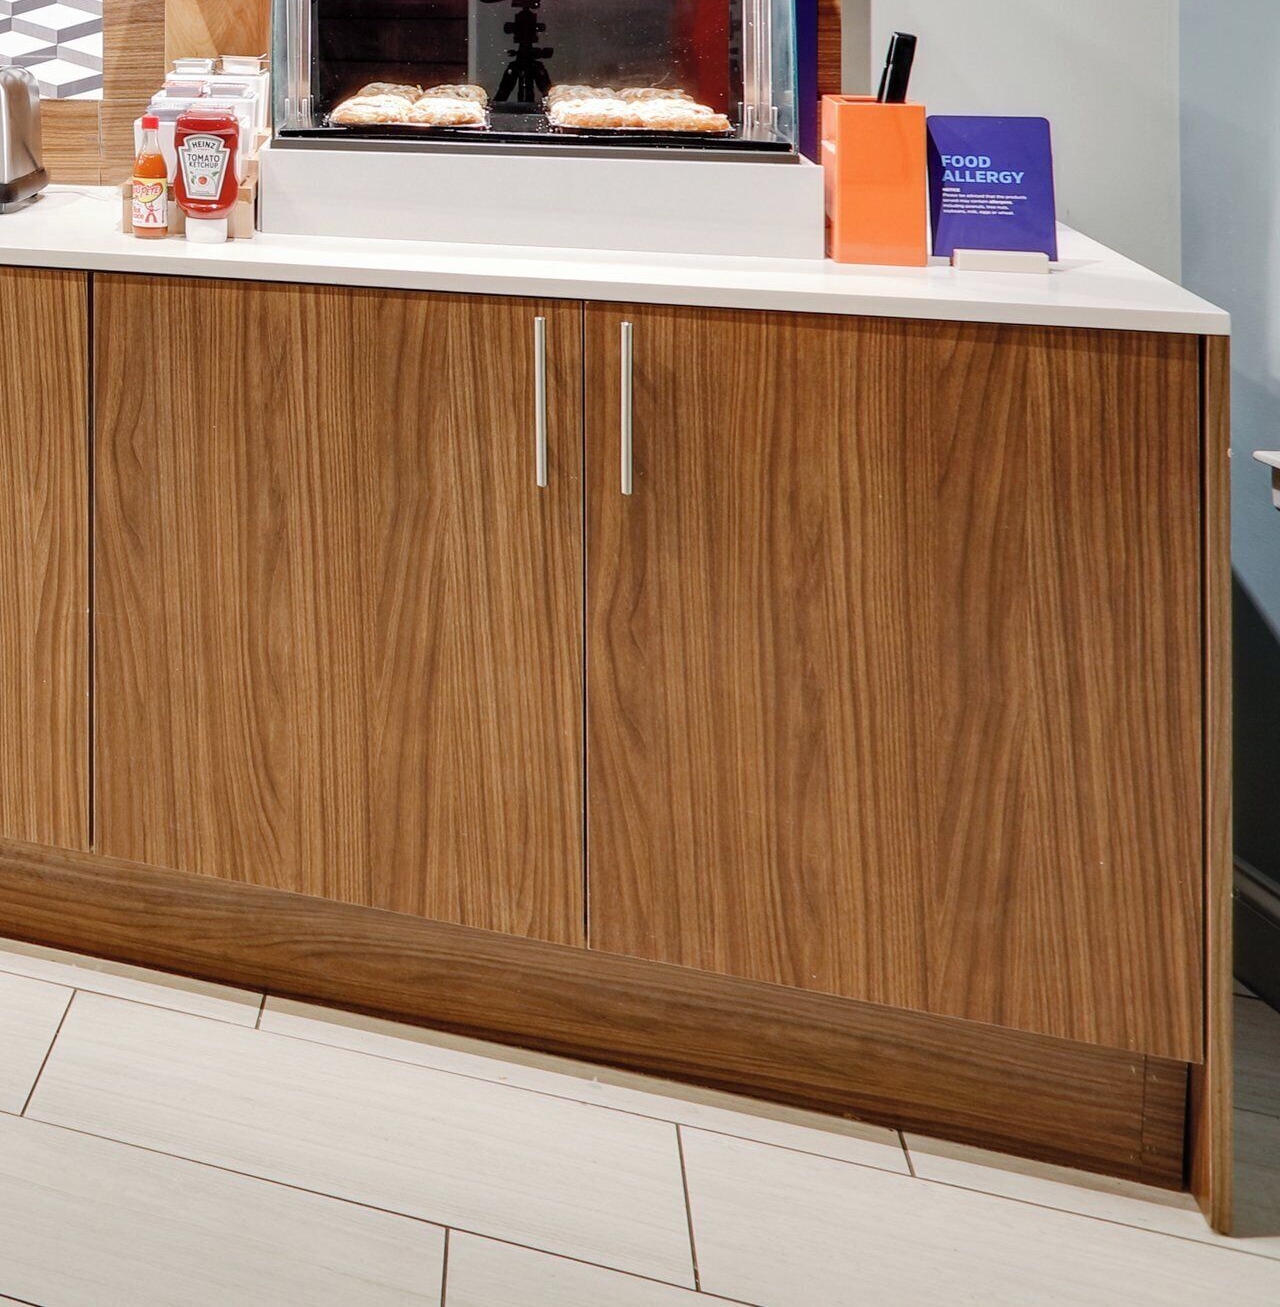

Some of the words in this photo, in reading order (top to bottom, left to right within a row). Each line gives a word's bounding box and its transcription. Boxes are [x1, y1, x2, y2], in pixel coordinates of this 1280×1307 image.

[191, 140, 216, 150] HEINZ
[187, 153, 220, 163] TOMATO
[941, 155, 991, 168] FOOD
[189, 161, 219, 169] KETCHUP
[942, 170, 1024, 184] ALLERGY
